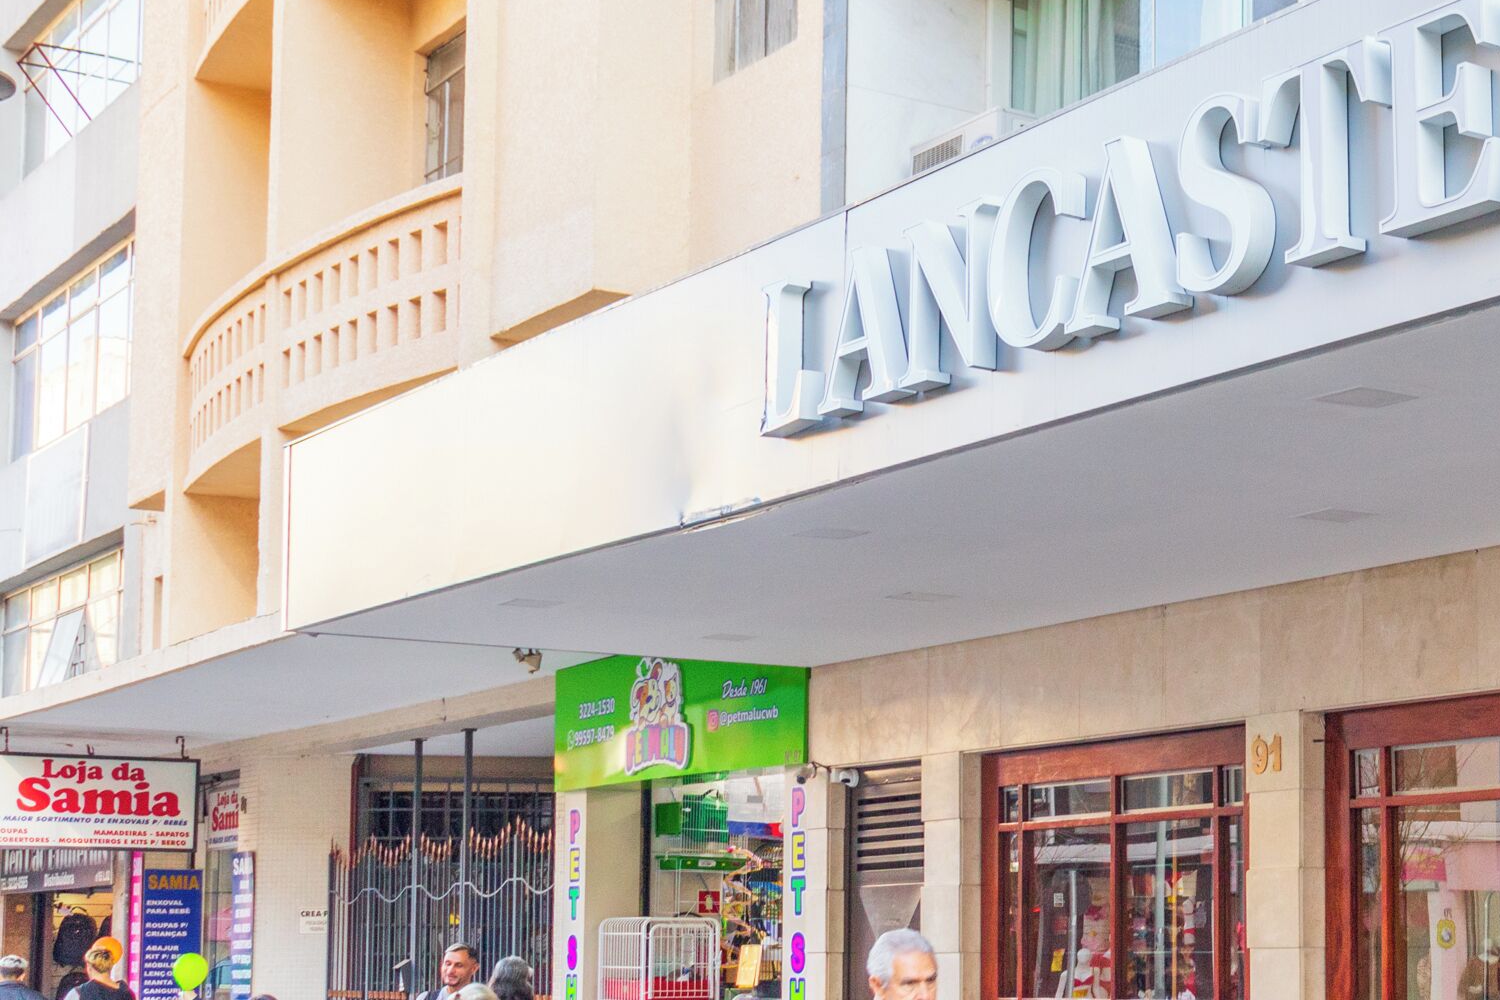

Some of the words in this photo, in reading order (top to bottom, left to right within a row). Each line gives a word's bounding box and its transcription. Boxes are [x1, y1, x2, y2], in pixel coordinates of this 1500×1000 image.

[722, 680, 748, 699] Desde
[749, 678, 768, 696] 1961
[578, 698, 615, 720] 3224-1530
[719, 708, 779, 727] @petmalucwb
[1251, 734, 1282, 775] 91
[42, 759, 103, 784] Loja
[111, 763, 146, 782] da
[16, 777, 181, 817] Samia
[35, 816, 92, 824] SORTIMENTO
[212, 804, 239, 832] Sami
[59, 837, 121, 845] MOSQUETEIROS
[93, 829, 148, 837] MAMADEIRAS
[147, 874, 200, 891] SAMIA
[146, 899, 184, 907] ENXOVAL
[300, 910, 322, 918] CREA
[145, 930, 188, 939] CRIANÇAS
